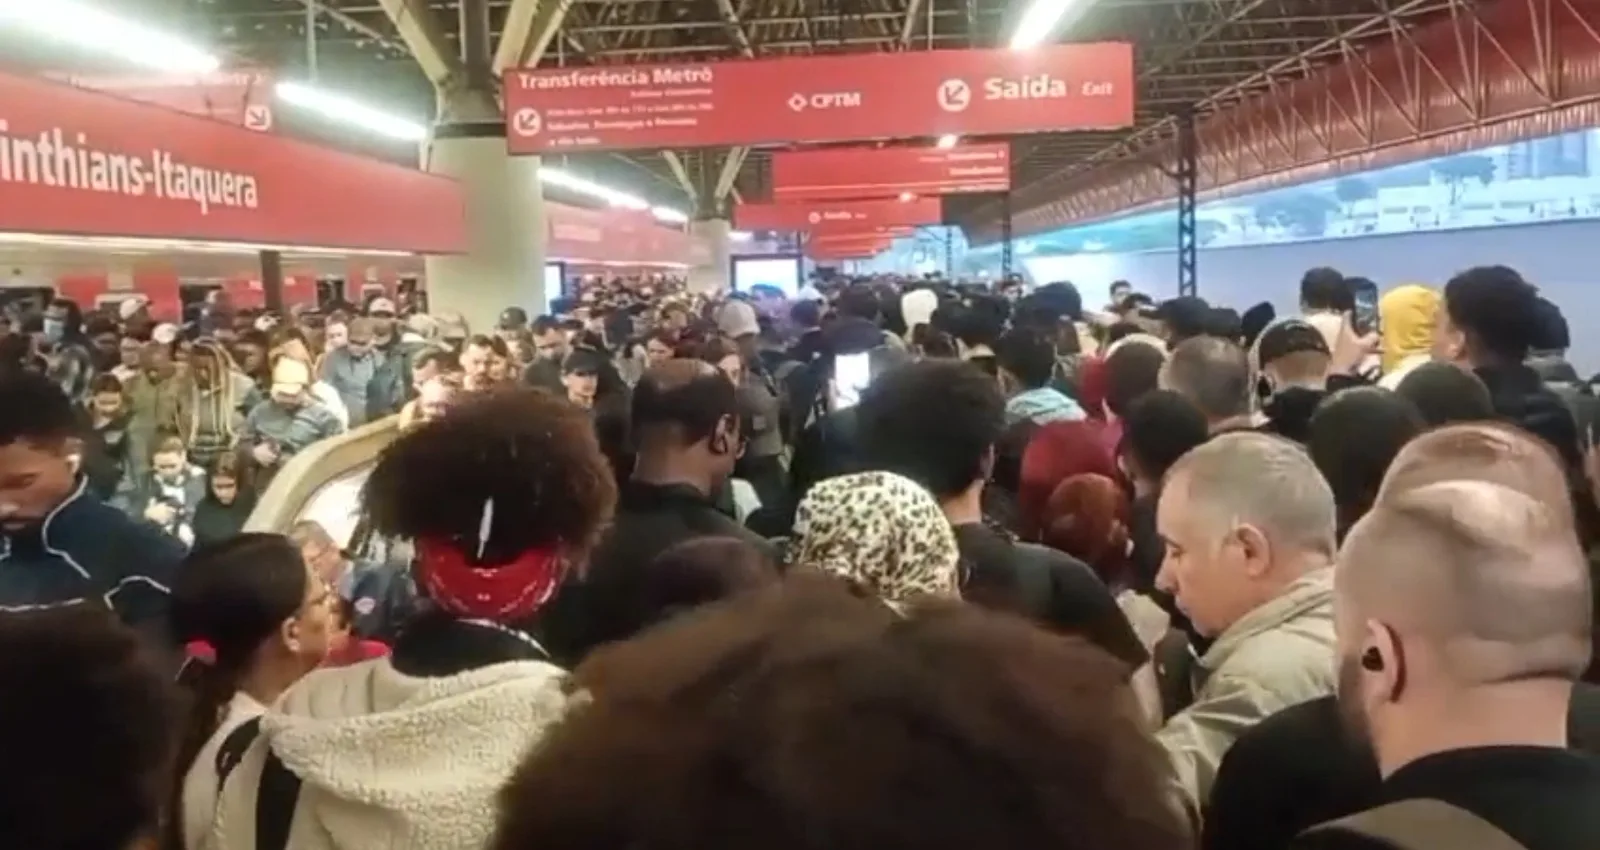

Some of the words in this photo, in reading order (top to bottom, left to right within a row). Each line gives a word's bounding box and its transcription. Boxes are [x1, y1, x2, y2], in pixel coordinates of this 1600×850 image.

[518, 69, 649, 89] Transferência
[983, 73, 1067, 100] Saída
[811, 92, 861, 109] CPTM
